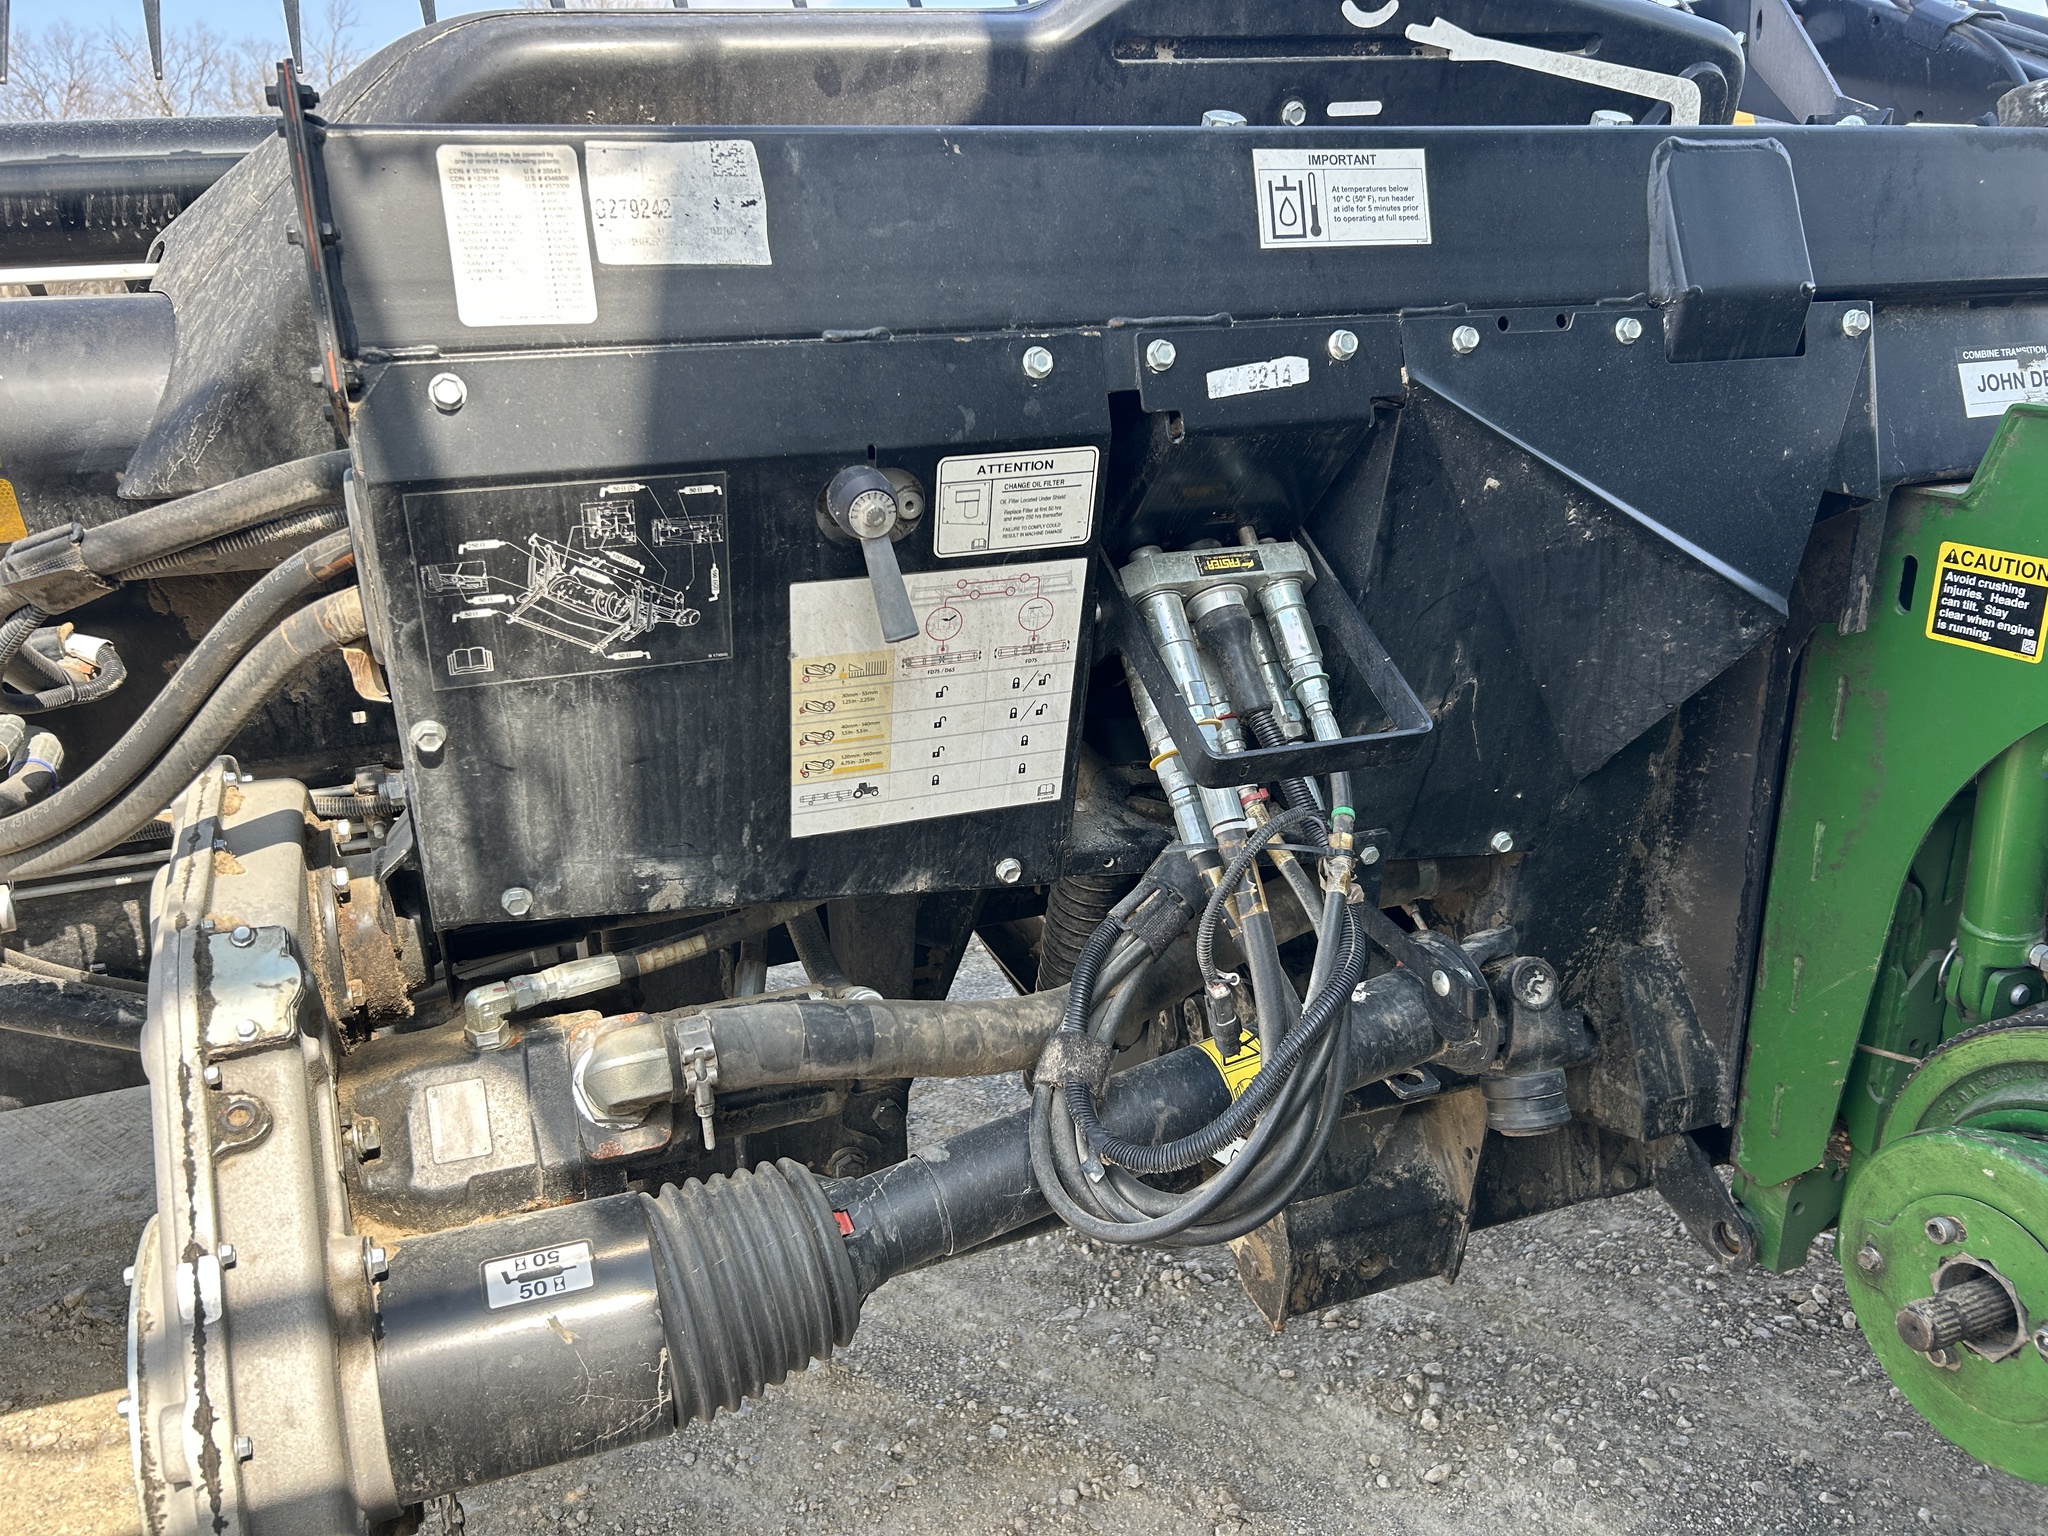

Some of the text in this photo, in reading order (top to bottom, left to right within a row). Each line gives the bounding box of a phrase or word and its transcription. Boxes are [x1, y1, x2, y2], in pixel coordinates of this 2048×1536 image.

[1308, 155, 1376, 165] IMPORTANT
[1341, 186, 1386, 195] temperatures
[1343, 215, 1376, 223] operating
[1399, 214, 1420, 222] speed.
[1963, 349, 2000, 359] COMBINE
[1977, 371, 2026, 392] JOHN
[977, 460, 1054, 475] ATTENTION
[1004, 482, 1030, 490] CHANGE
[1044, 479, 1065, 487] FILTER
[1207, 559, 1240, 570] FASTER
[1961, 551, 2048, 581] CAUTION
[1945, 572, 2026, 598] Avoid crushing
[1944, 584, 2030, 610] injuries. Header
[1941, 598, 2009, 620] can tilt. Stay
[1937, 619, 1992, 641] is running.
[1939, 609, 2035, 637] clear when engine
[533, 1251, 560, 1267] 50
[520, 1281, 547, 1300] 50
